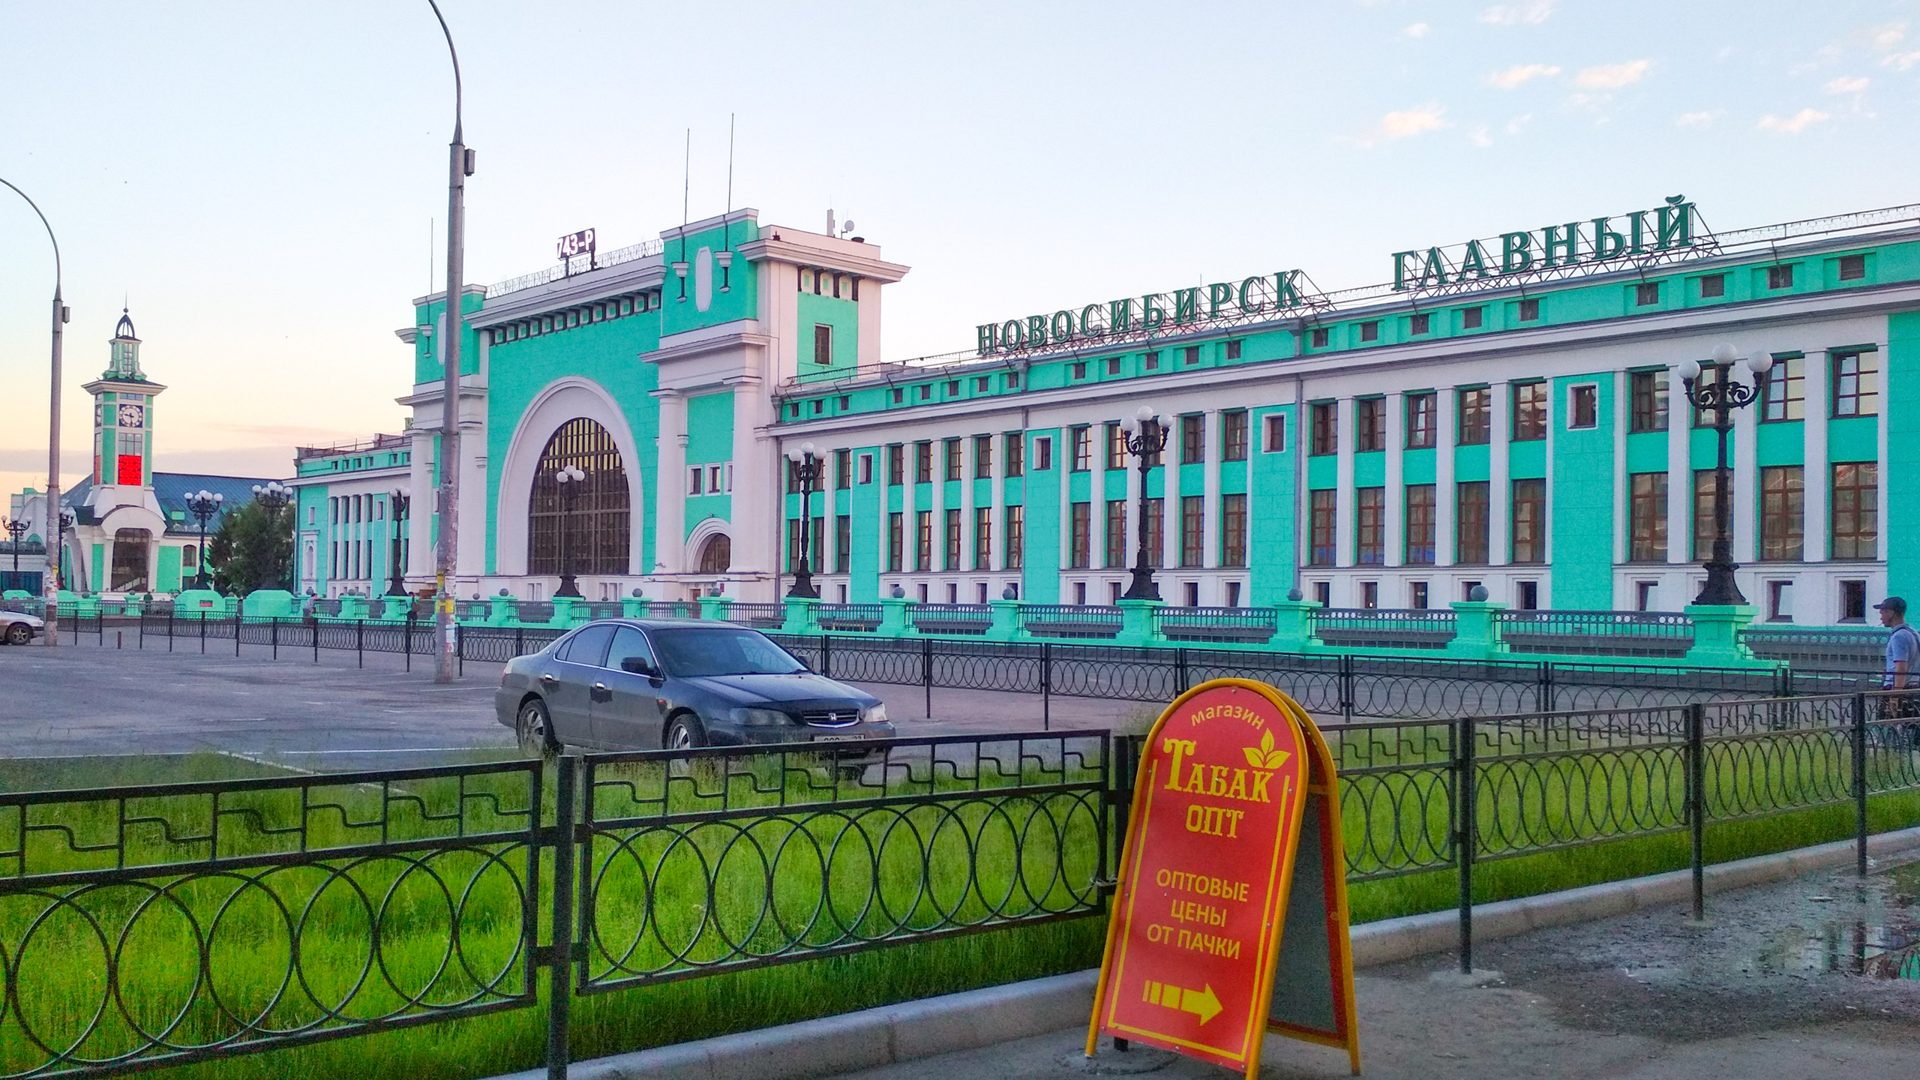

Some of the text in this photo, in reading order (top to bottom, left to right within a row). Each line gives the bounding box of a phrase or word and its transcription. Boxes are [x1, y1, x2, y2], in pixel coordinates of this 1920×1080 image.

[976, 194, 1696, 356] НОВОСИБИРСК ГЛАВНЫЙ
[1191, 705, 1265, 730] магазин
[1185, 804, 1244, 838] ОПТ
[1156, 868, 1250, 902] ОПТОВЫЕ
[1170, 899, 1228, 927] ЦЕНЫ
[1146, 923, 1241, 960] ОТ ПАЧКИ
